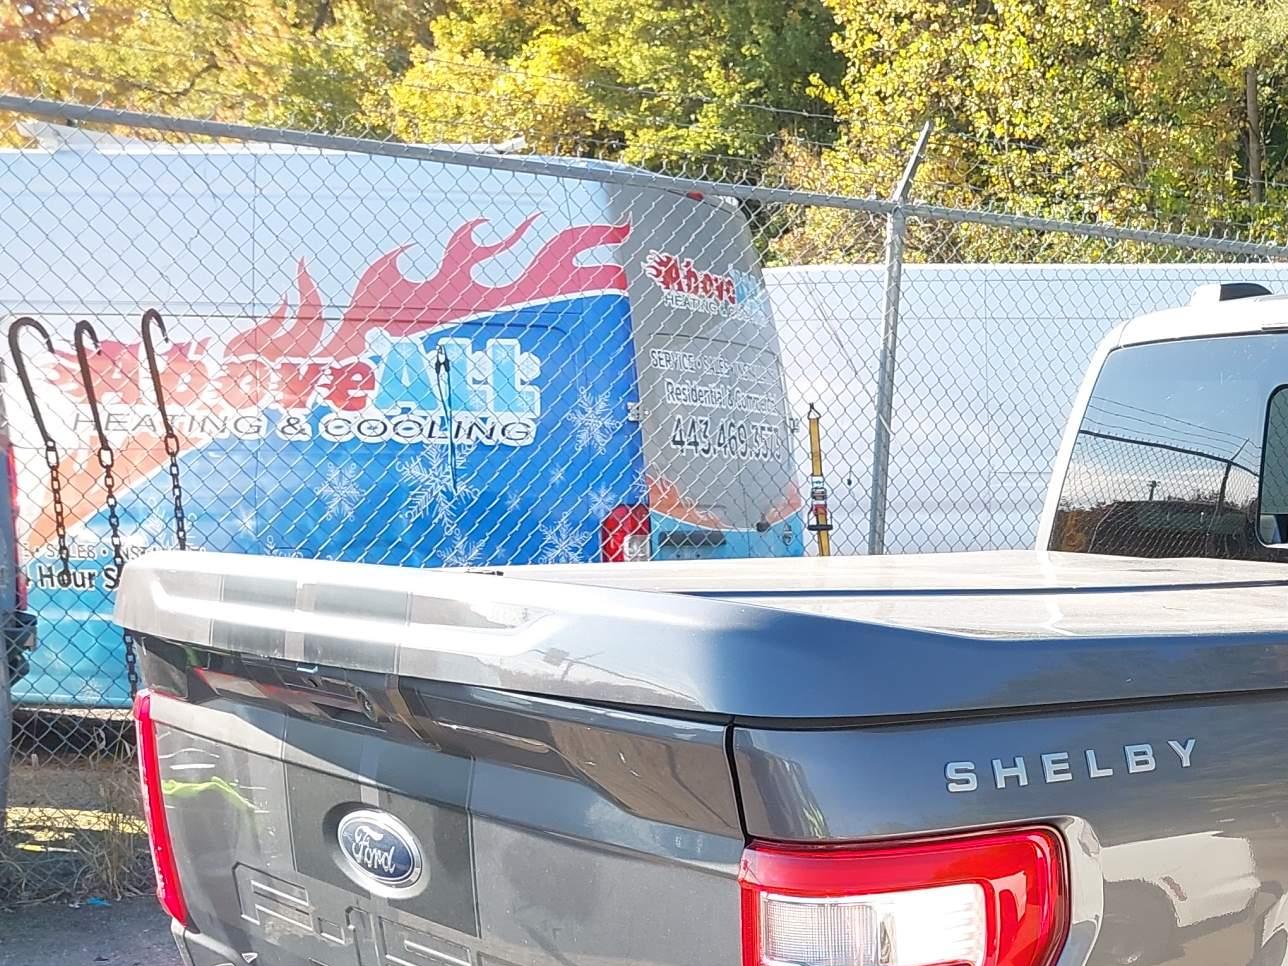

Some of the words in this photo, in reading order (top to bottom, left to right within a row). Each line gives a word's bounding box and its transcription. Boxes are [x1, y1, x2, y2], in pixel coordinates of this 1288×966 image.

[72, 412, 263, 435] HEATING
[281, 416, 306, 436] &
[324, 417, 532, 441] COOLING
[945, 739, 1196, 793] SHELBY
[351, 825, 397, 874] Ford
